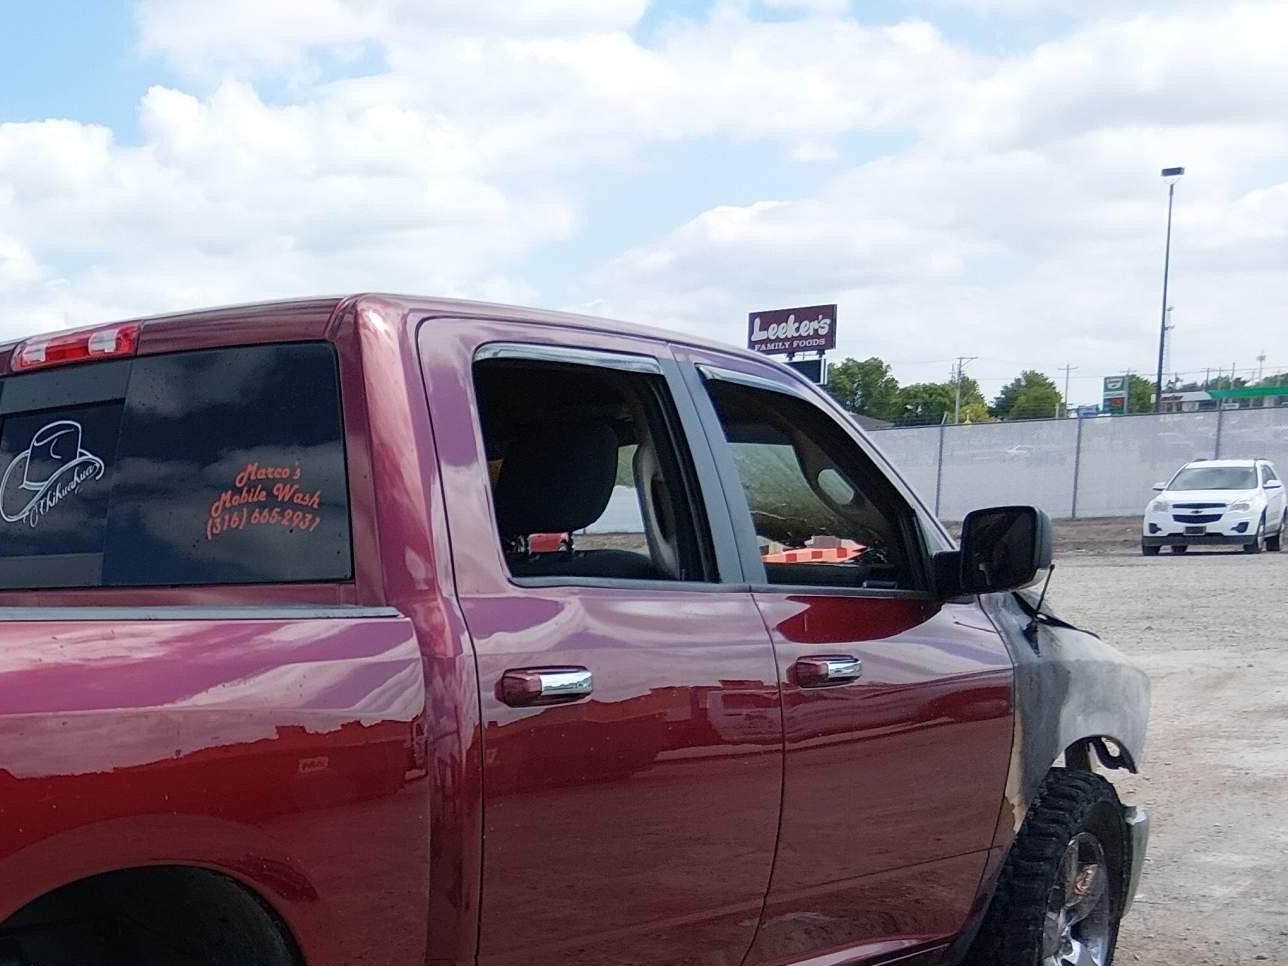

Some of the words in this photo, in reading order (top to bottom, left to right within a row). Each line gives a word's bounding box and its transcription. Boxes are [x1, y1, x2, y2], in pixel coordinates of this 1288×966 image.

[751, 314, 831, 341] Leeker's
[755, 341, 791, 352] FAMILY
[793, 338, 825, 348] FOODS
[235, 462, 301, 488] Marco's
[29, 463, 96, 527] Chihuahua
[211, 485, 267, 517] Mobile
[273, 483, 320, 509] Wash
[207, 508, 247, 540] (316)
